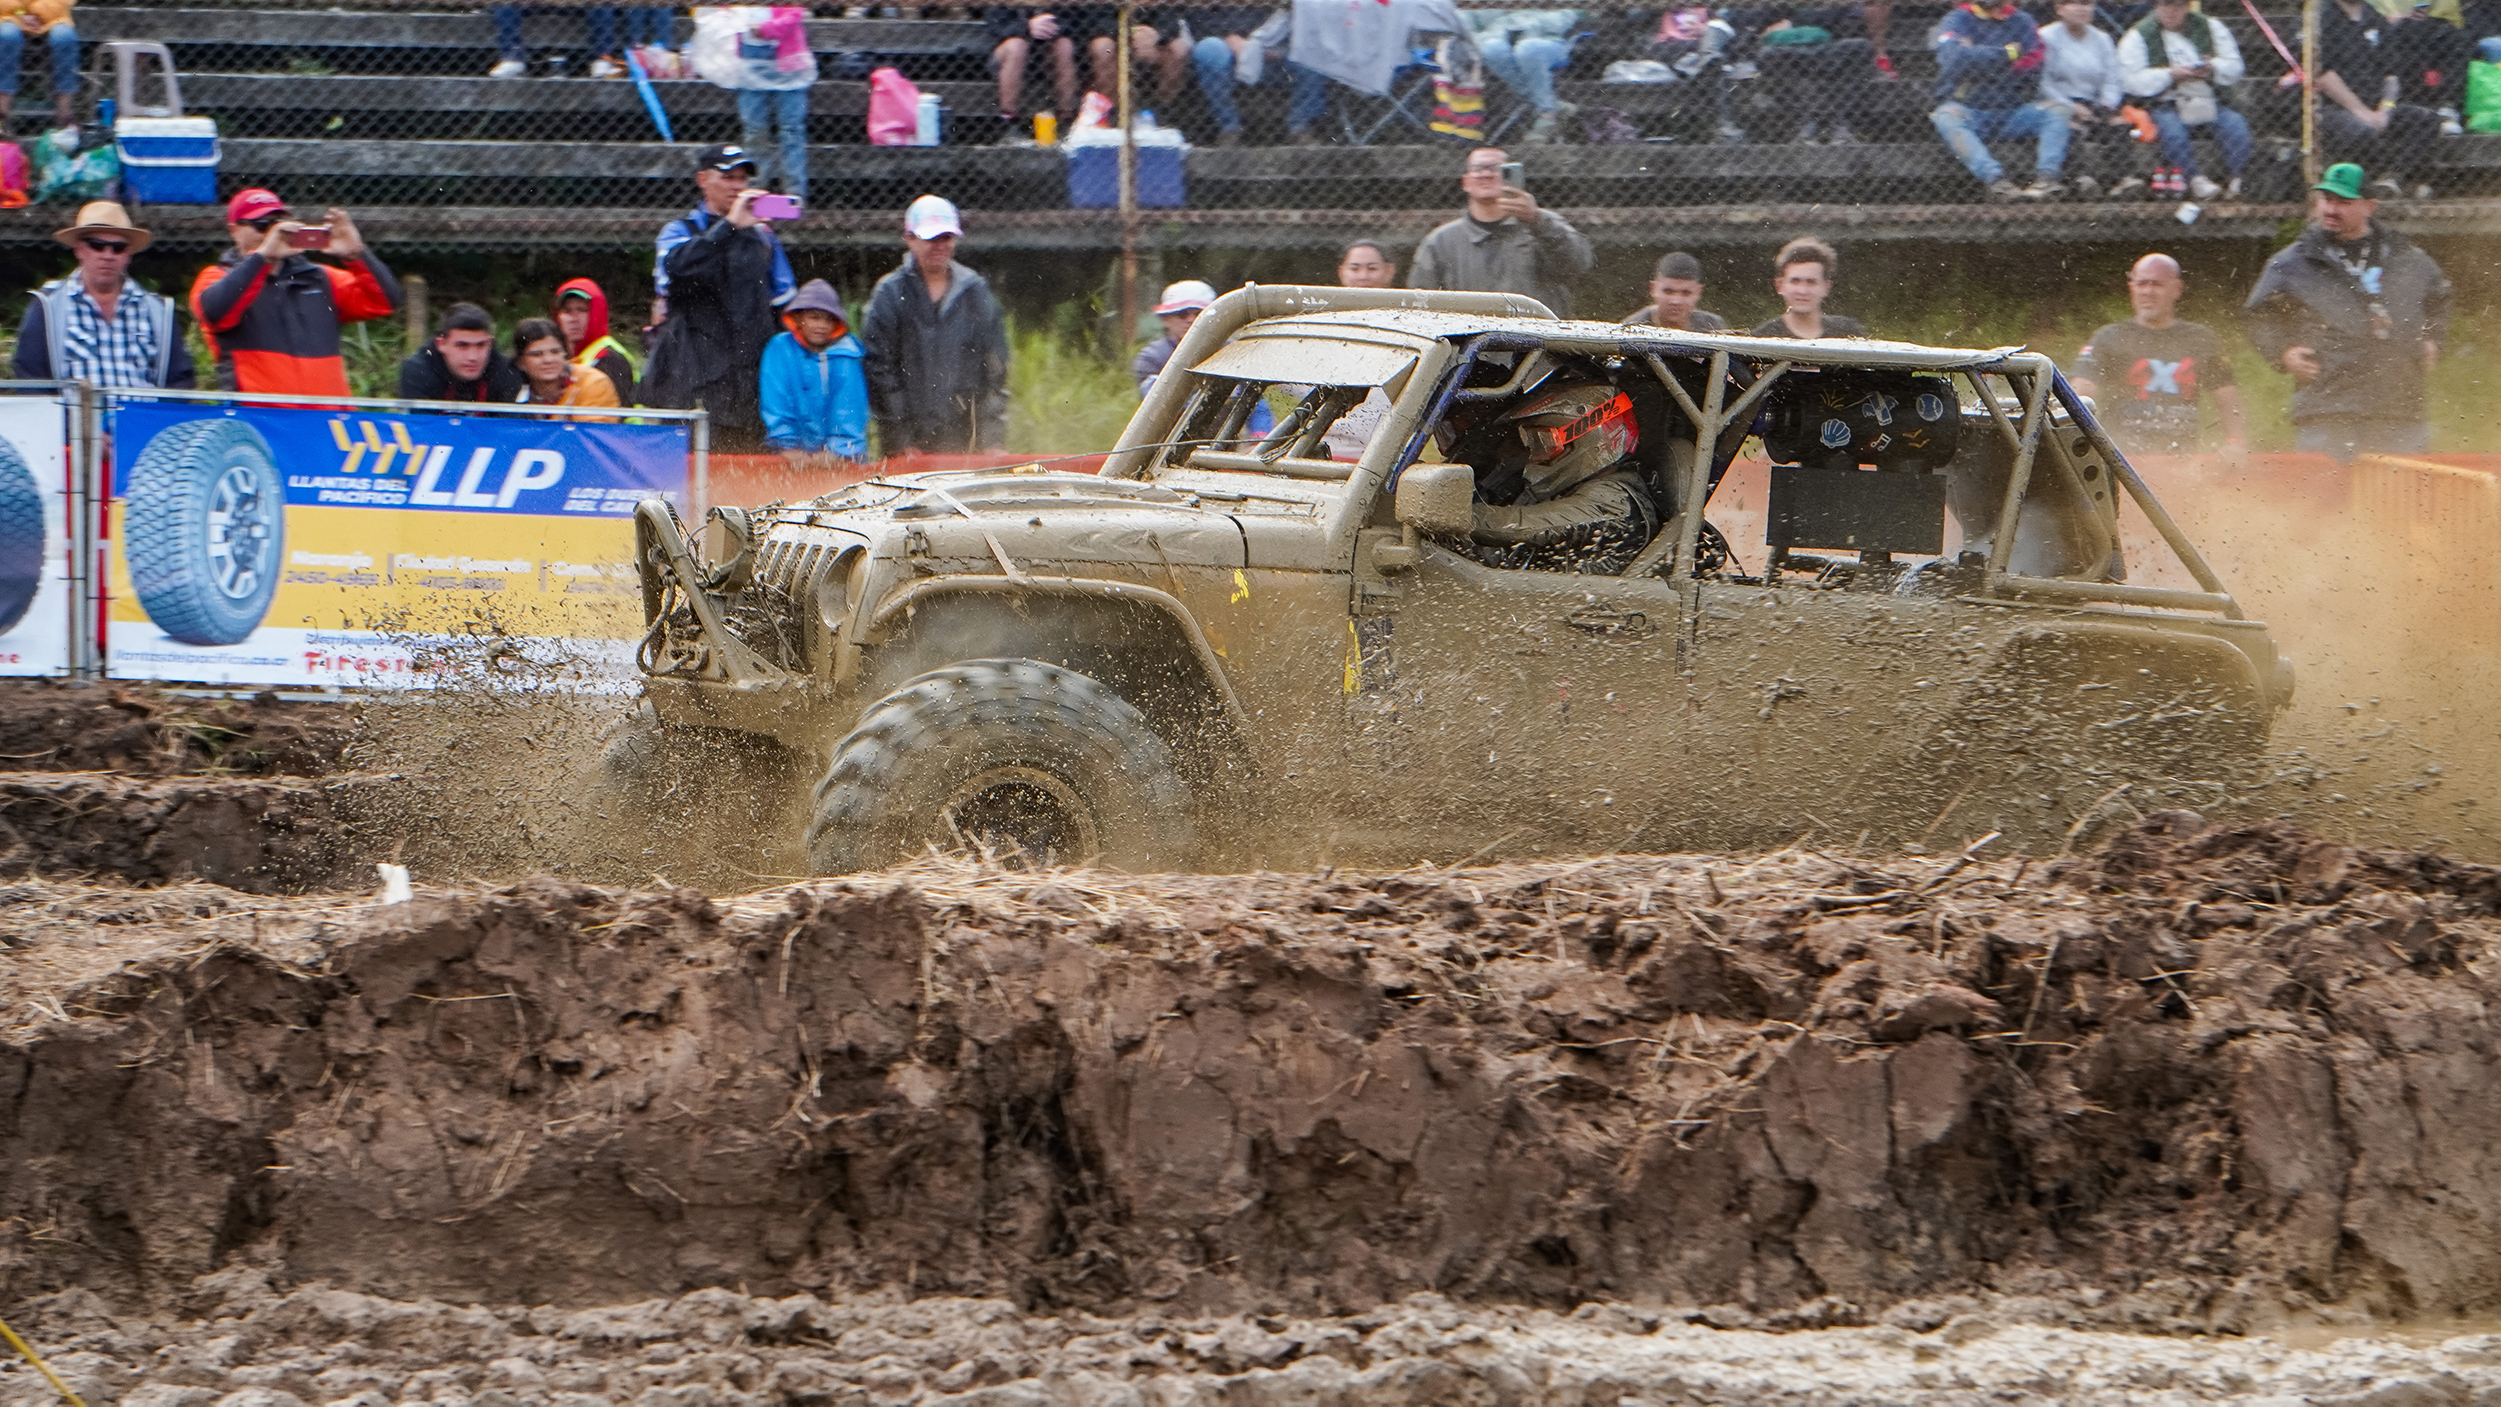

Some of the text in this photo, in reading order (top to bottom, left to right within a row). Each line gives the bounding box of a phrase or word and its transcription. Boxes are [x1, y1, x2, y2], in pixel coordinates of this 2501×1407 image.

[1562, 399, 1621, 442] 100%
[288, 475, 411, 492] LLANTAS DEL
[409, 445, 567, 508] LLP
